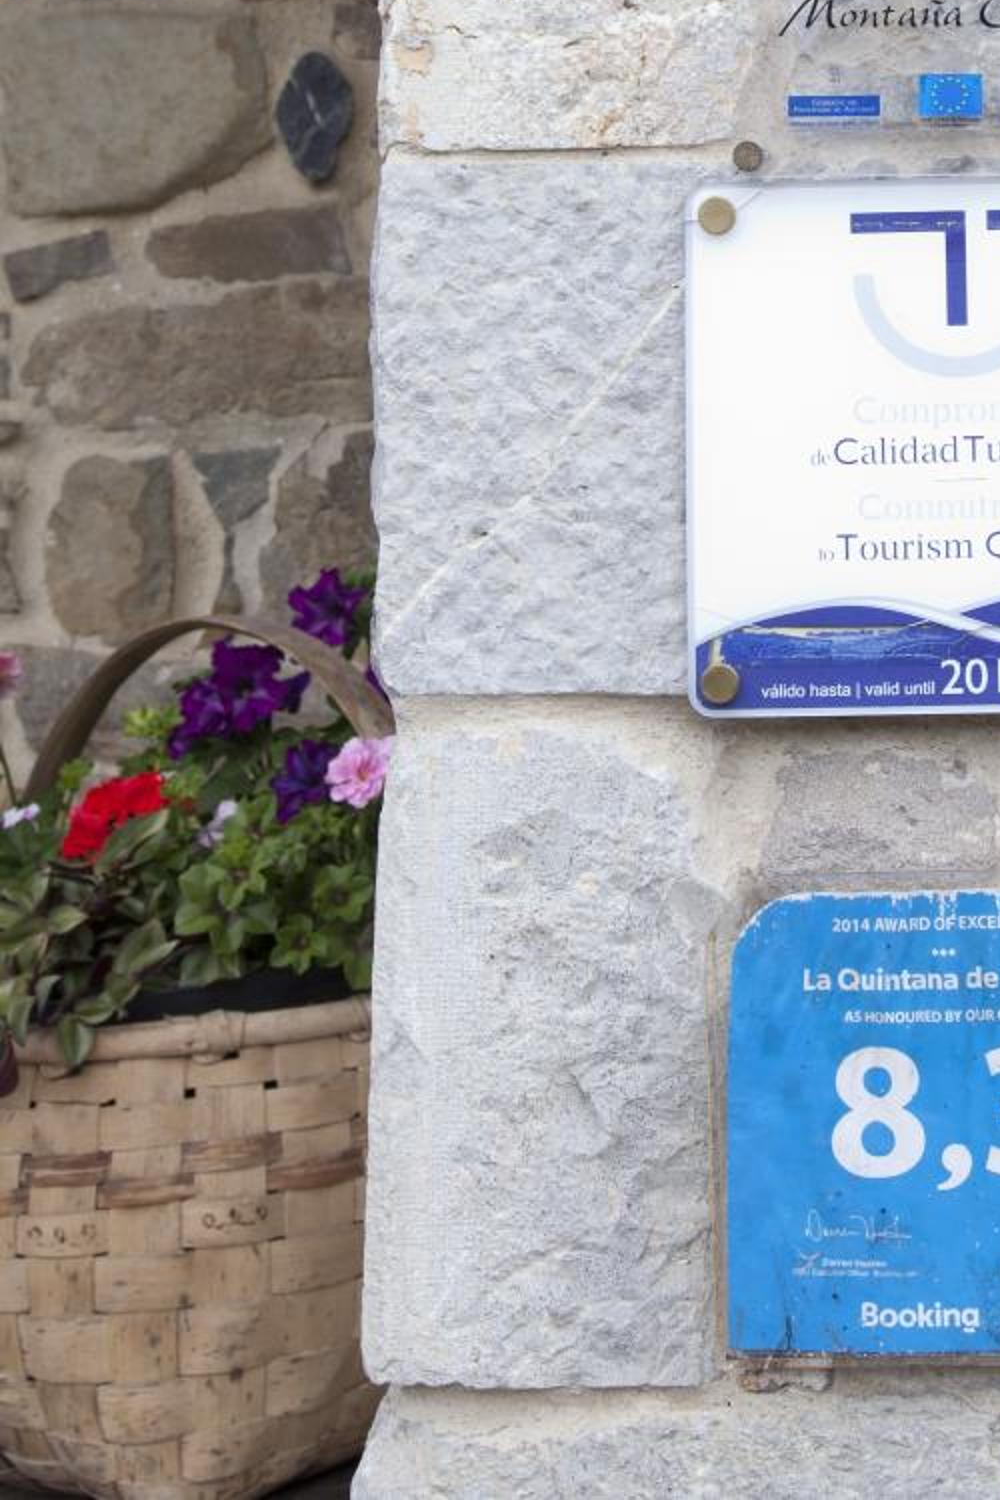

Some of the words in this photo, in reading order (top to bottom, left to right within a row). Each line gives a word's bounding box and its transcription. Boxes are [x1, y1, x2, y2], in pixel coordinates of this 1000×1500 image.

[810, 448, 832, 467] de
[832, 436, 959, 466] Calidad
[817, 546, 835, 563] to
[835, 532, 974, 562] Tourism
[760, 683, 806, 700] válido
[809, 682, 851, 698] hasta
[864, 681, 900, 697] valid
[904, 680, 935, 696] until
[832, 917, 870, 933] 2014
[873, 916, 931, 933] AWARD
[934, 915, 956, 931] OF
[803, 968, 831, 992] La
[837, 966, 959, 992] Quintana
[965, 965, 999, 989] de
[844, 1009, 863, 1024] AS
[864, 1009, 942, 1025] HONOURED
[945, 1009, 962, 1024] BY
[965, 1008, 995, 1023] OUR
